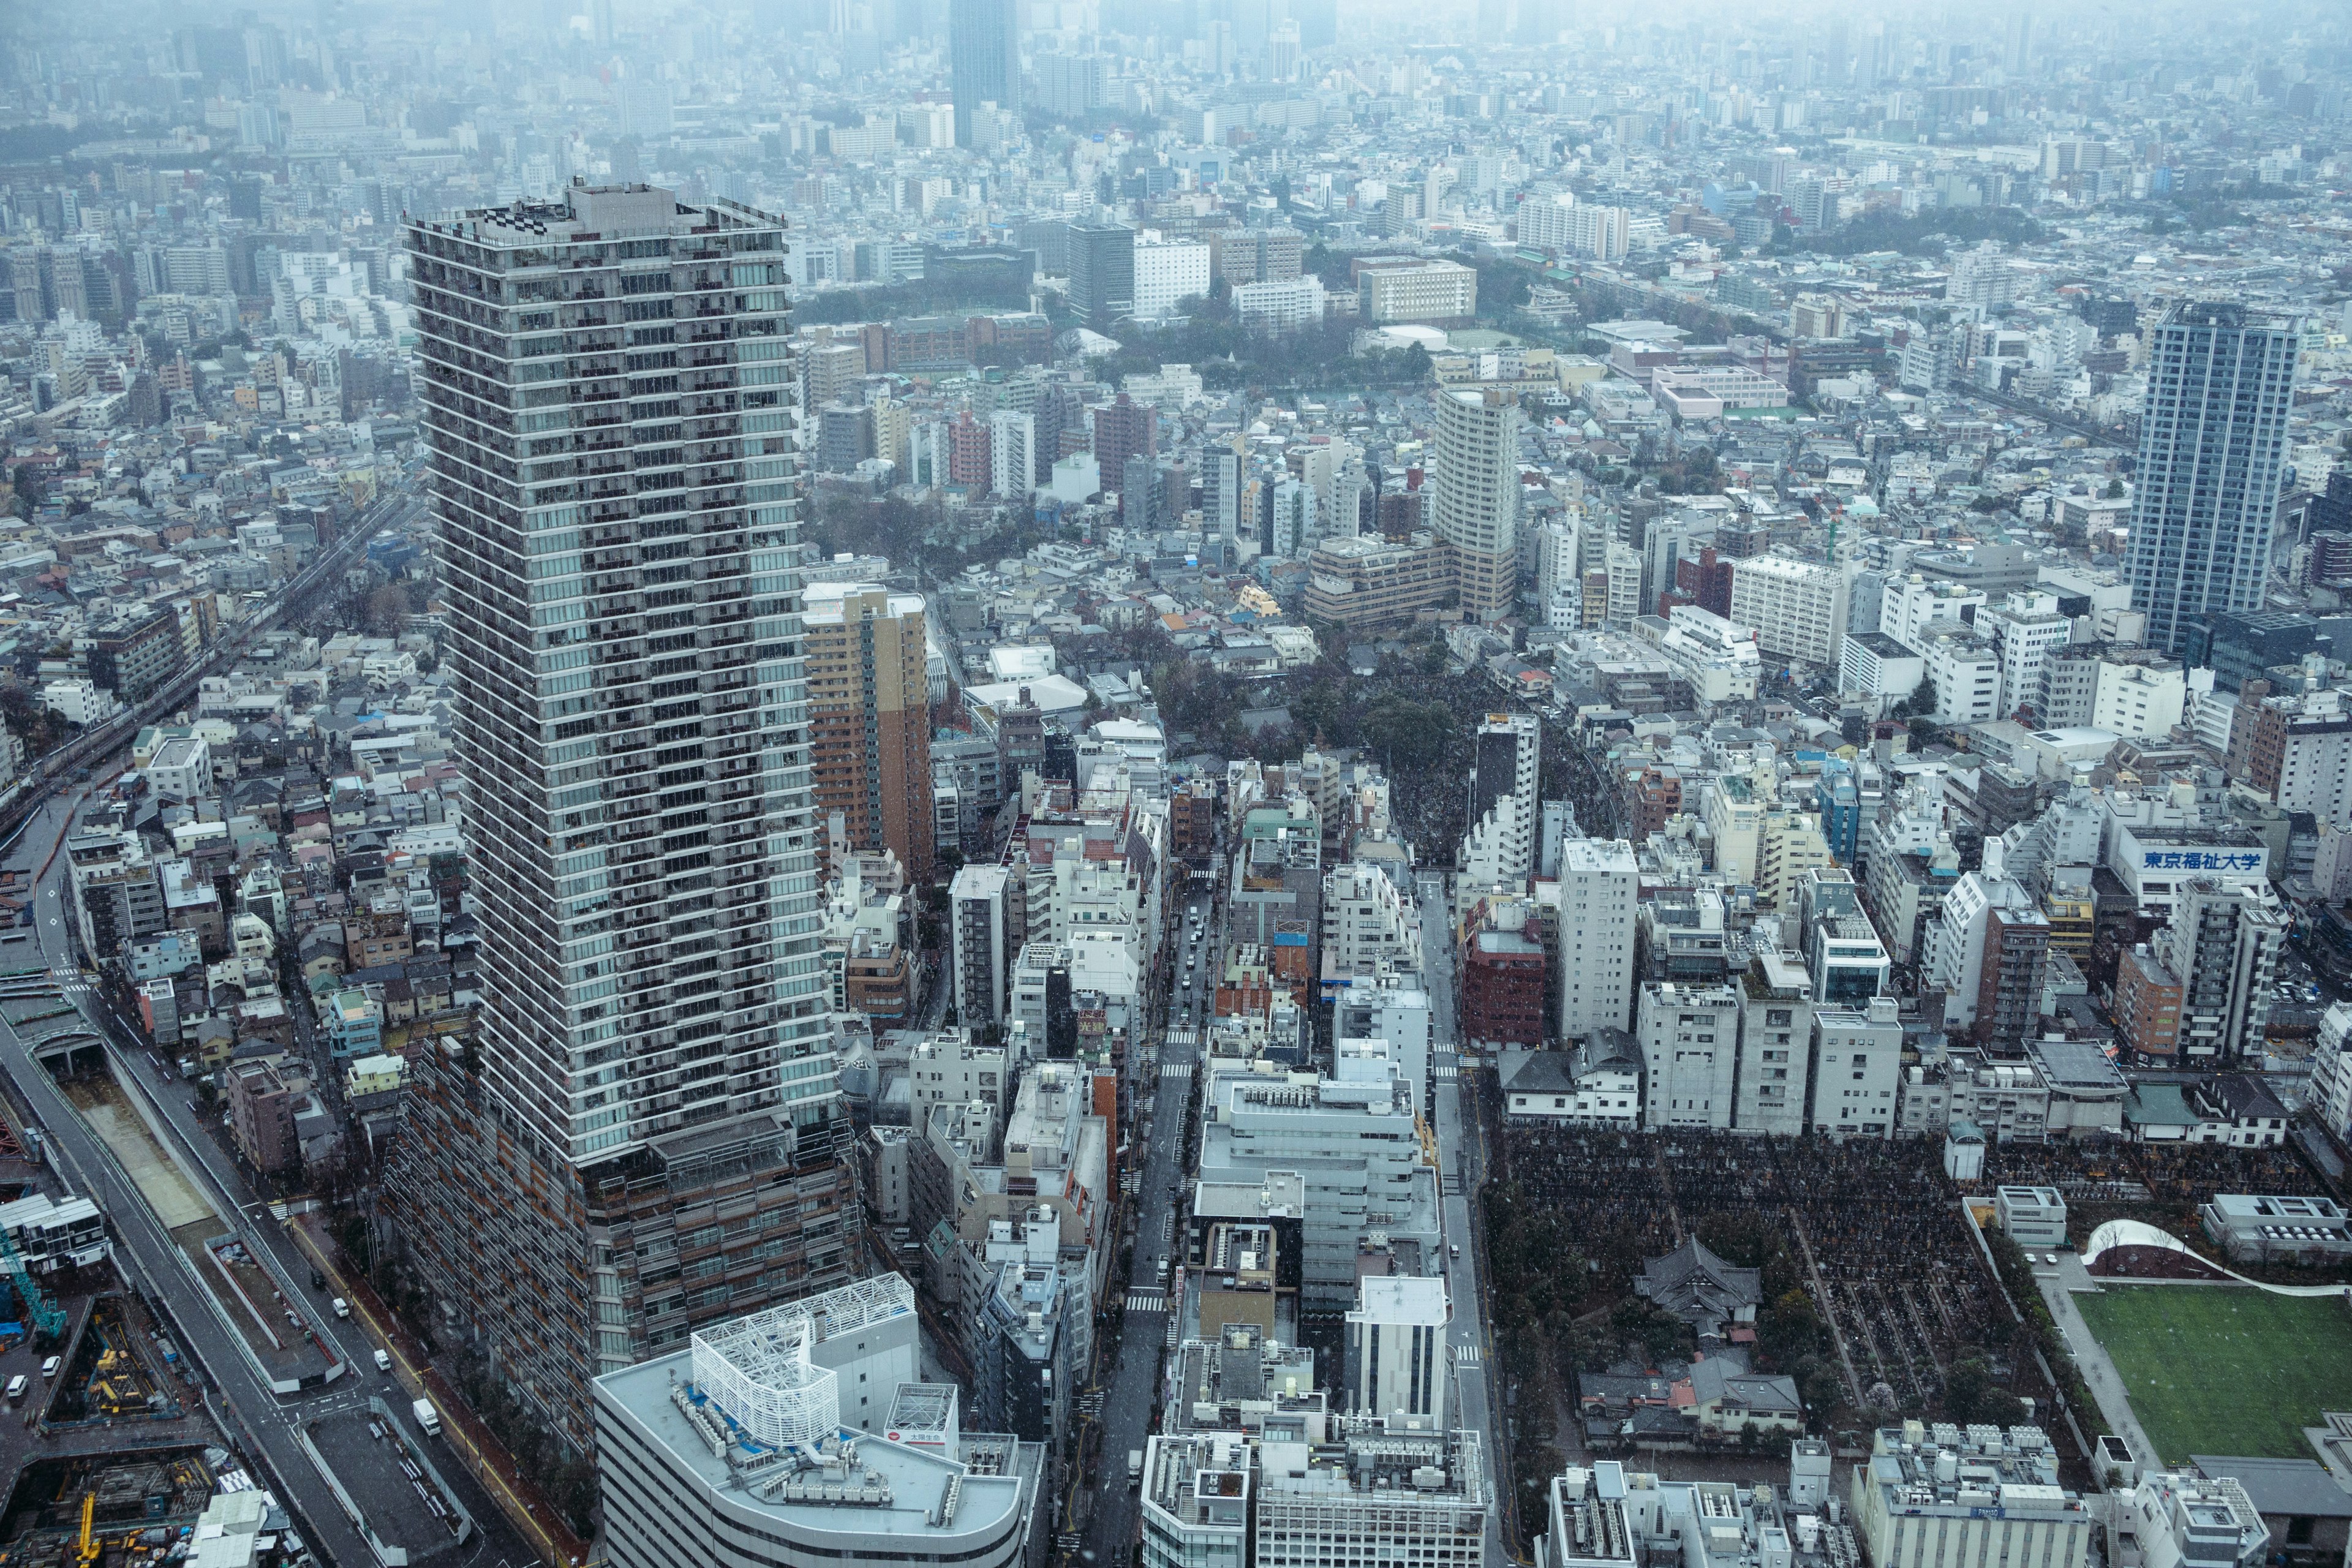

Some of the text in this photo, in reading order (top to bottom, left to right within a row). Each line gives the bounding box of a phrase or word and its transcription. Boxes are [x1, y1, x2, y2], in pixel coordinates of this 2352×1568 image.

[2143, 851, 2261, 871] 東京福祉大学
[1079, 1021, 1104, 1032] 光建
